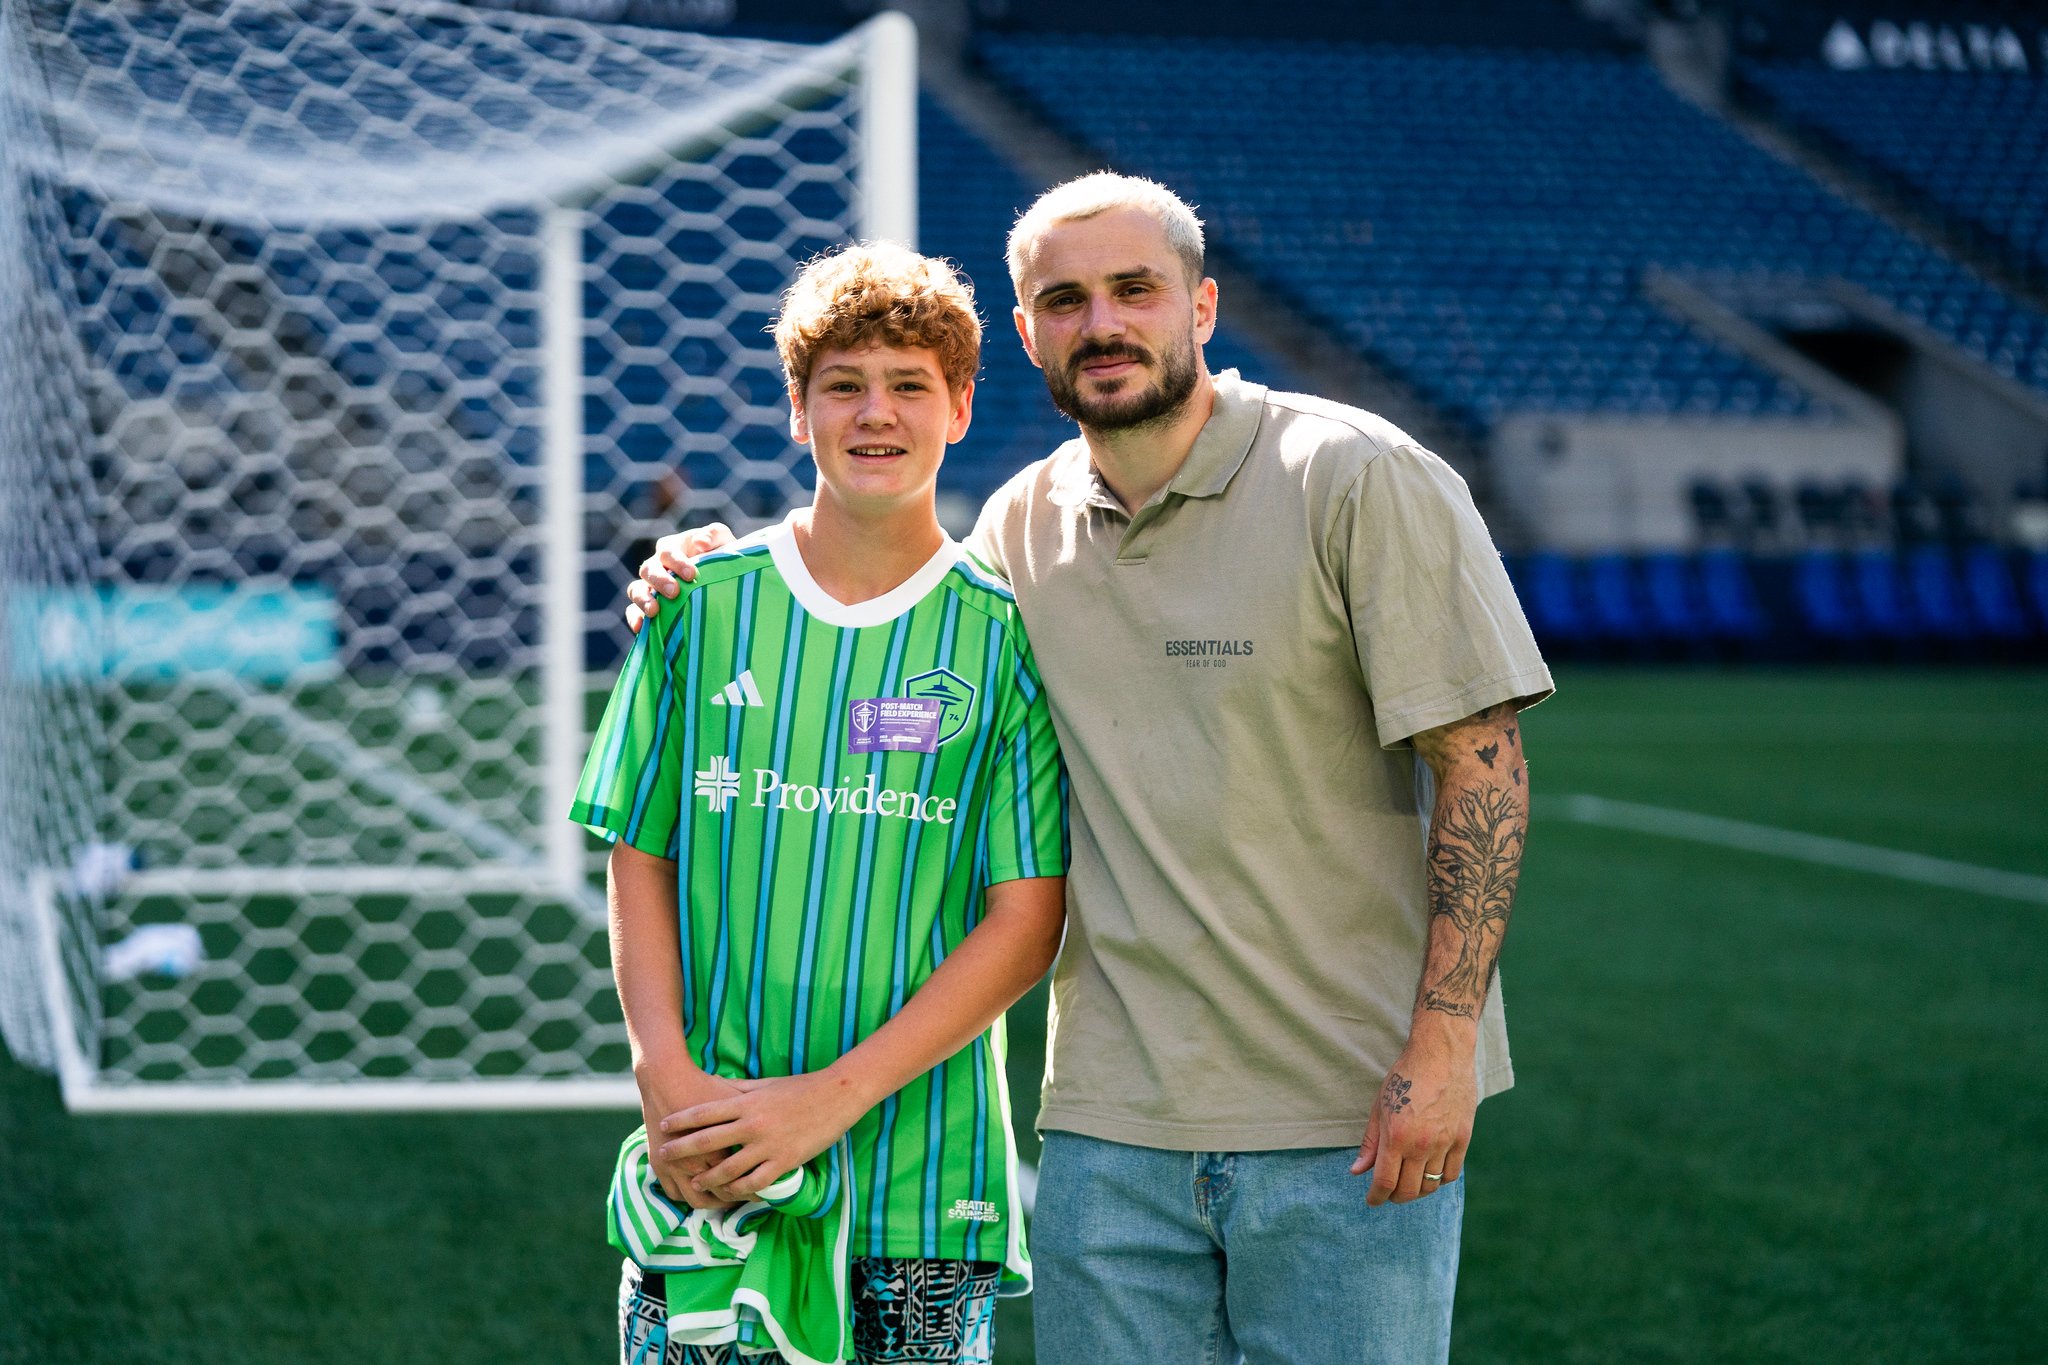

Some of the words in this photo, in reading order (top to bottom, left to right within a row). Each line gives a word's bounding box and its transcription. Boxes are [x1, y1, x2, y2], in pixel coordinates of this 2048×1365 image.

[1868, 20, 2029, 71] DELTA
[1165, 640, 1254, 656] ESSENTIALS
[1186, 659, 1200, 668] FEAR
[1202, 659, 1210, 668] OF
[1213, 659, 1227, 668] GOD
[880, 702, 923, 711] POST-MATCH
[897, 710, 937, 719] EXPERIENCE
[949, 713, 960, 722] 74
[751, 768, 957, 824] Providence
[955, 1199, 995, 1212] SEATTLE
[948, 1208, 1000, 1223] SOUNDERS
